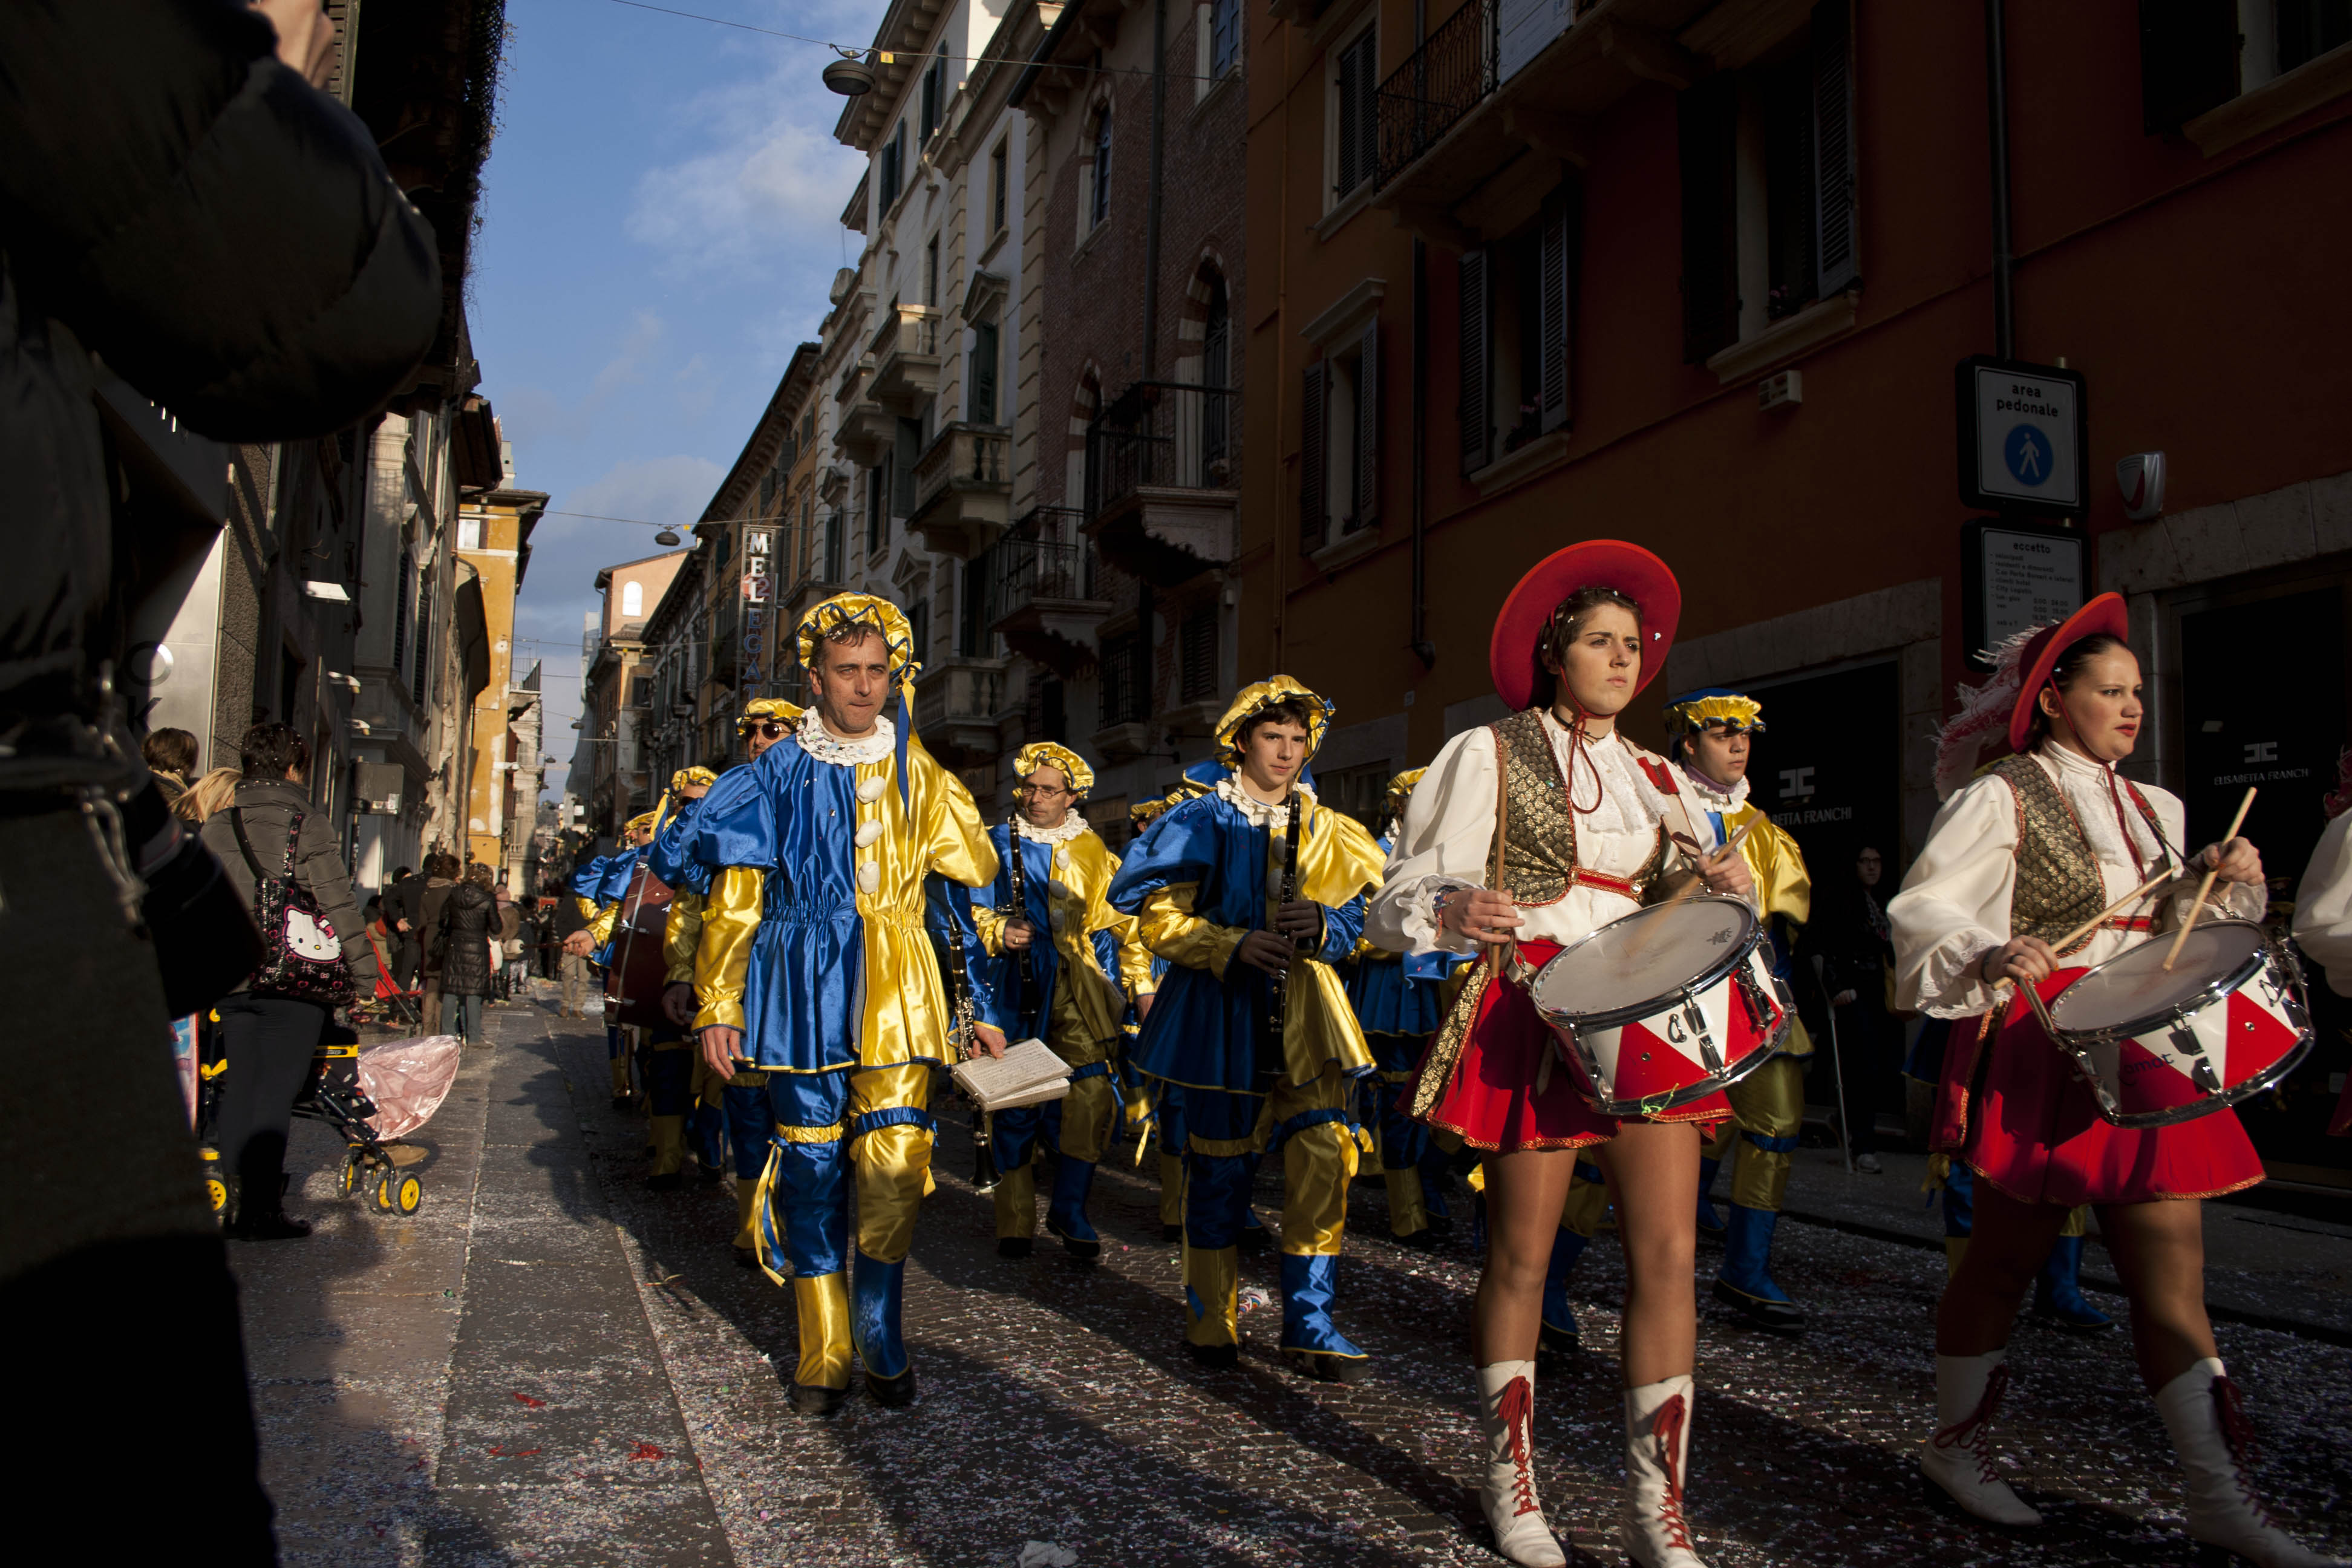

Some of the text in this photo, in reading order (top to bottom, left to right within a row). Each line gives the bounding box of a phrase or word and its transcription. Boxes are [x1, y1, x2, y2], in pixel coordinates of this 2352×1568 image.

[2012, 385, 2042, 397] area
[1996, 398, 2059, 417] pedonale
[2013, 542, 2051, 554] eccetto
[2213, 772, 2266, 786] ELISABETTA
[1803, 806, 1852, 825] FRANCHI
